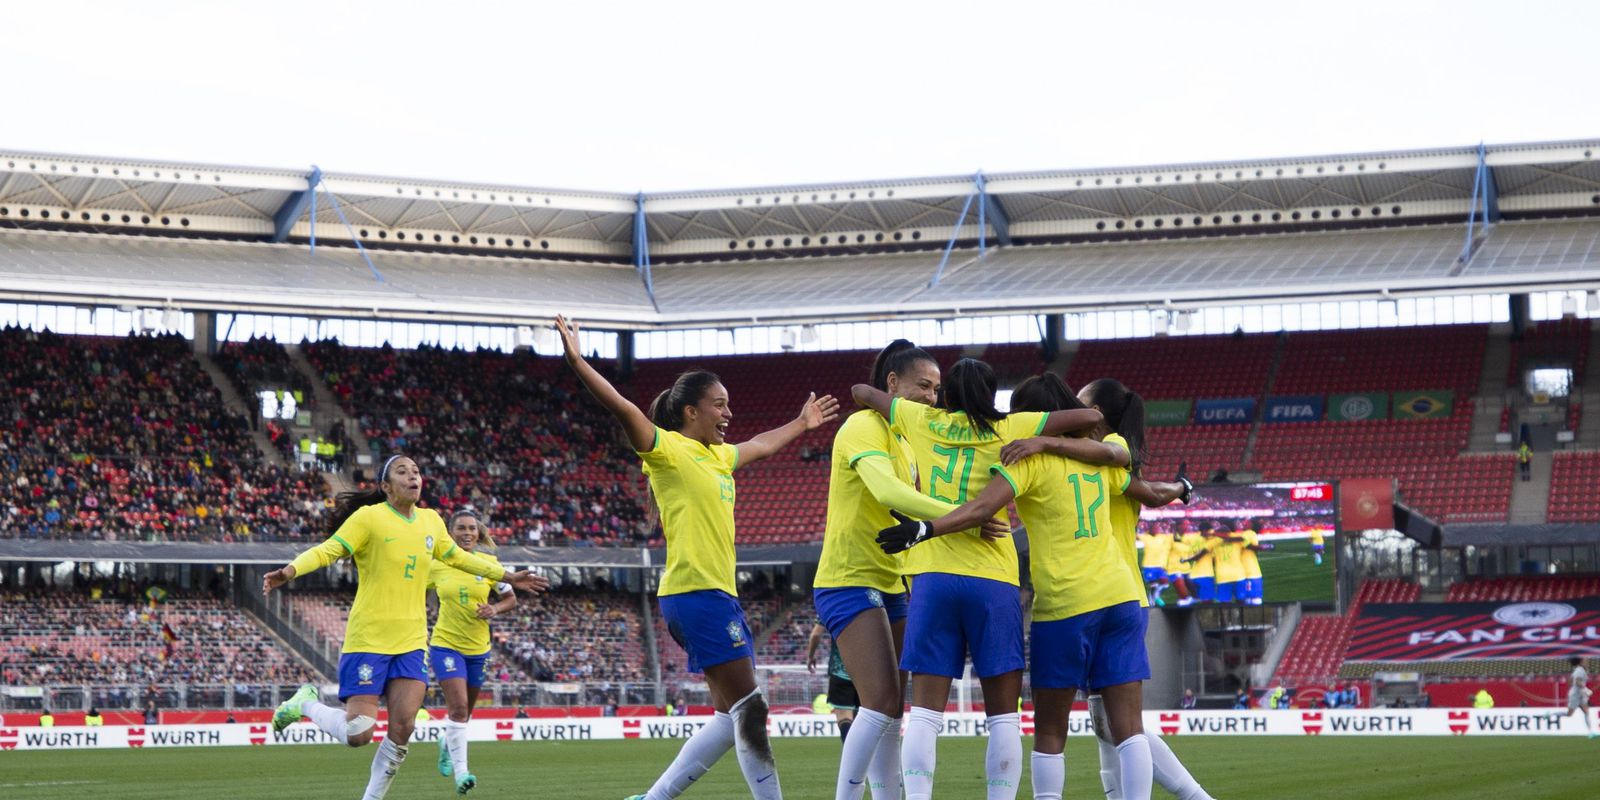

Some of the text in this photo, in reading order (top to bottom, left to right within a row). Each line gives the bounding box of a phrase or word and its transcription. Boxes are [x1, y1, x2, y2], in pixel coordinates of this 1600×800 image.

[1202, 408, 1247, 420] UEFA
[1272, 404, 1314, 419] FIFA
[929, 443, 977, 506] 21
[1067, 471, 1105, 540] 17
[403, 555, 417, 579] 2
[1408, 628, 1505, 645] FAN
[778, 720, 838, 736] WÜRT
[1187, 716, 1266, 733] WÜRTH
[1330, 715, 1412, 732] WÜRTH
[1477, 714, 1561, 732] WÜRTH
[25, 732, 98, 747] WÜRTH
[151, 730, 220, 746] WÜRTH
[520, 724, 592, 741] WÜRTH
